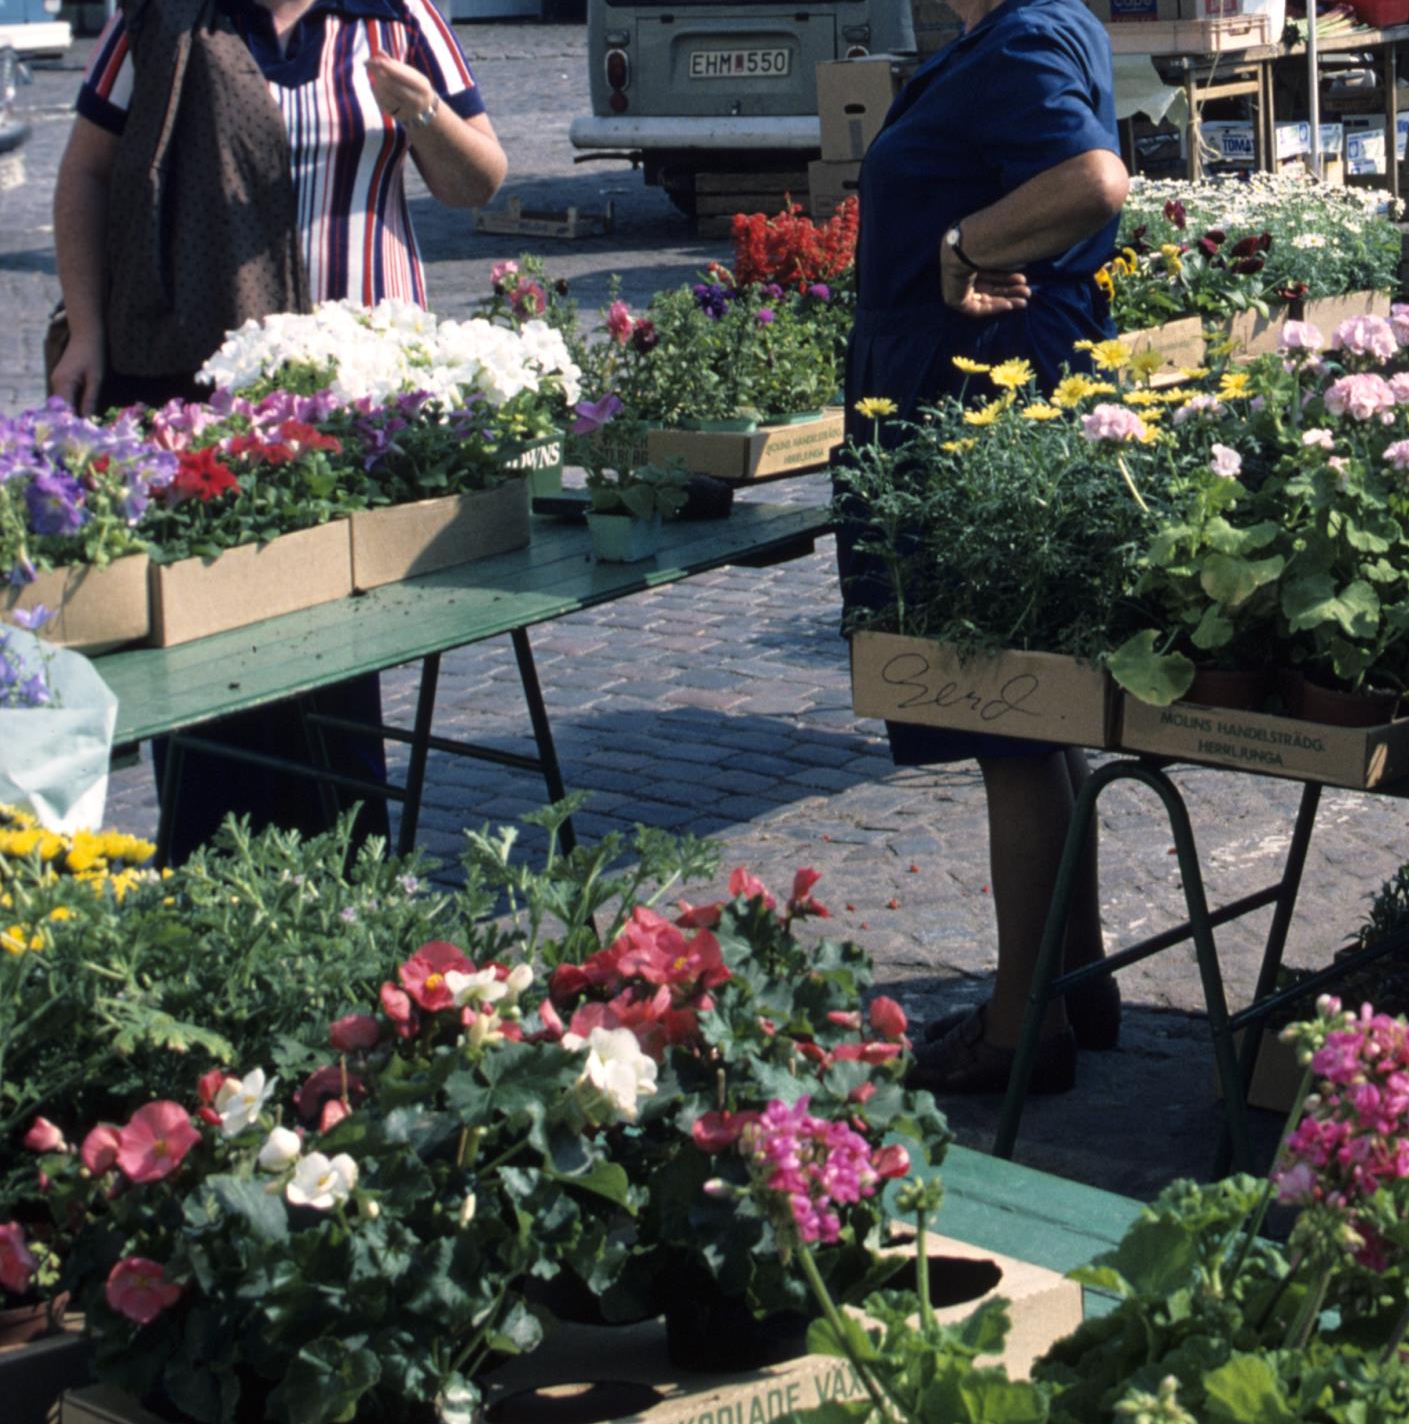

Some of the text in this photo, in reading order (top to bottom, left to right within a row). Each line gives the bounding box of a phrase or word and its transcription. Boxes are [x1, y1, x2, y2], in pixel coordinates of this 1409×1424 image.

[692, 51, 785, 74] EHM 550
[1160, 711, 1326, 753] MOLINS HANDELSTRÄDG.
[1198, 739, 1284, 768] HERRLJUNGA
[814, 1361, 864, 1403] VÄX
